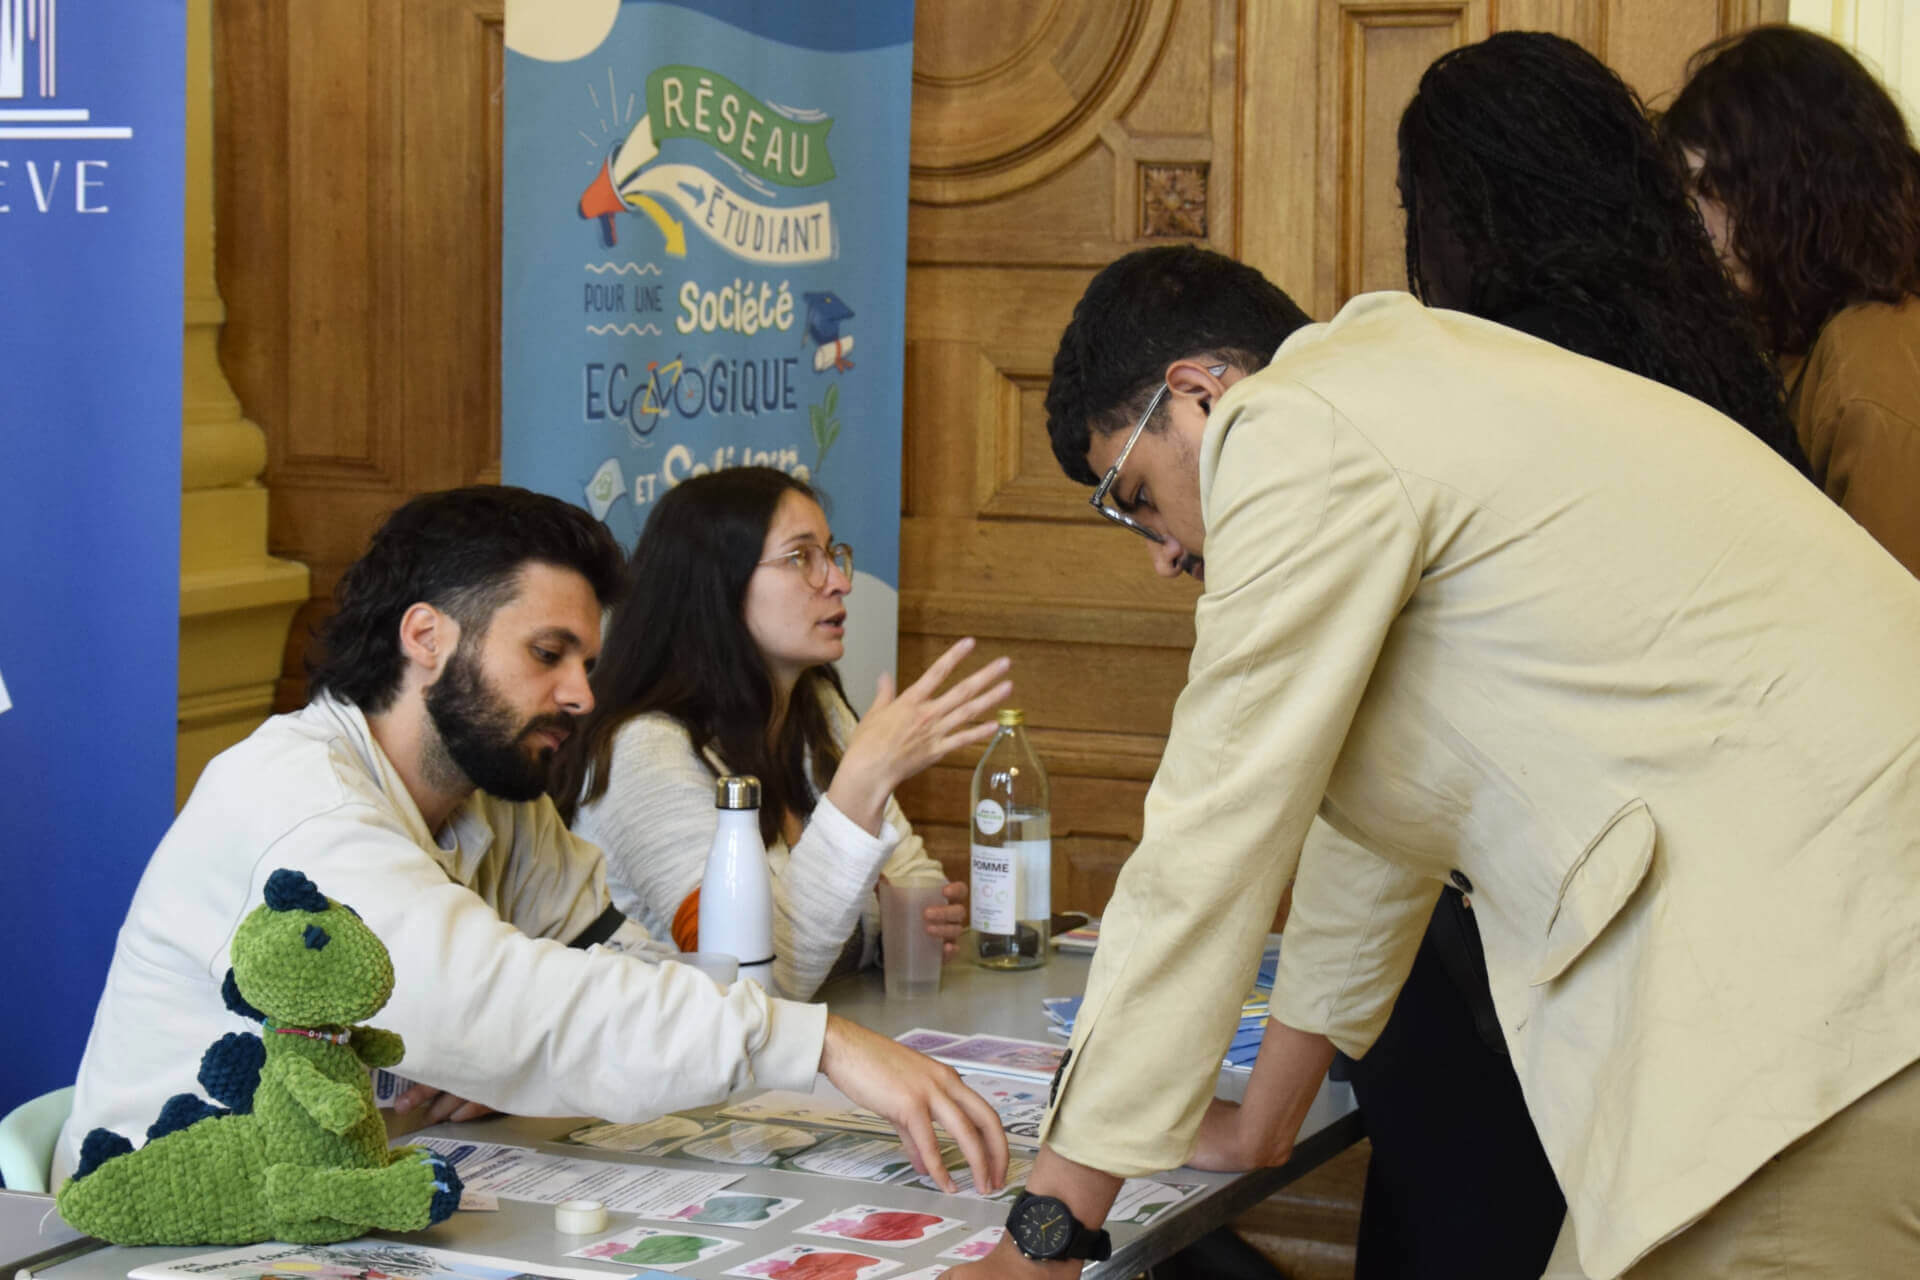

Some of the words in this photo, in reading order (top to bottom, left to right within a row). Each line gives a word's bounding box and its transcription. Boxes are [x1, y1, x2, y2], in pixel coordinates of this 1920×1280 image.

[584, 283, 625, 313] POUR
[634, 285, 664, 313] UNE
[676, 277, 795, 335] Société
[635, 474, 656, 504] ET
[973, 860, 1009, 873] POMME
